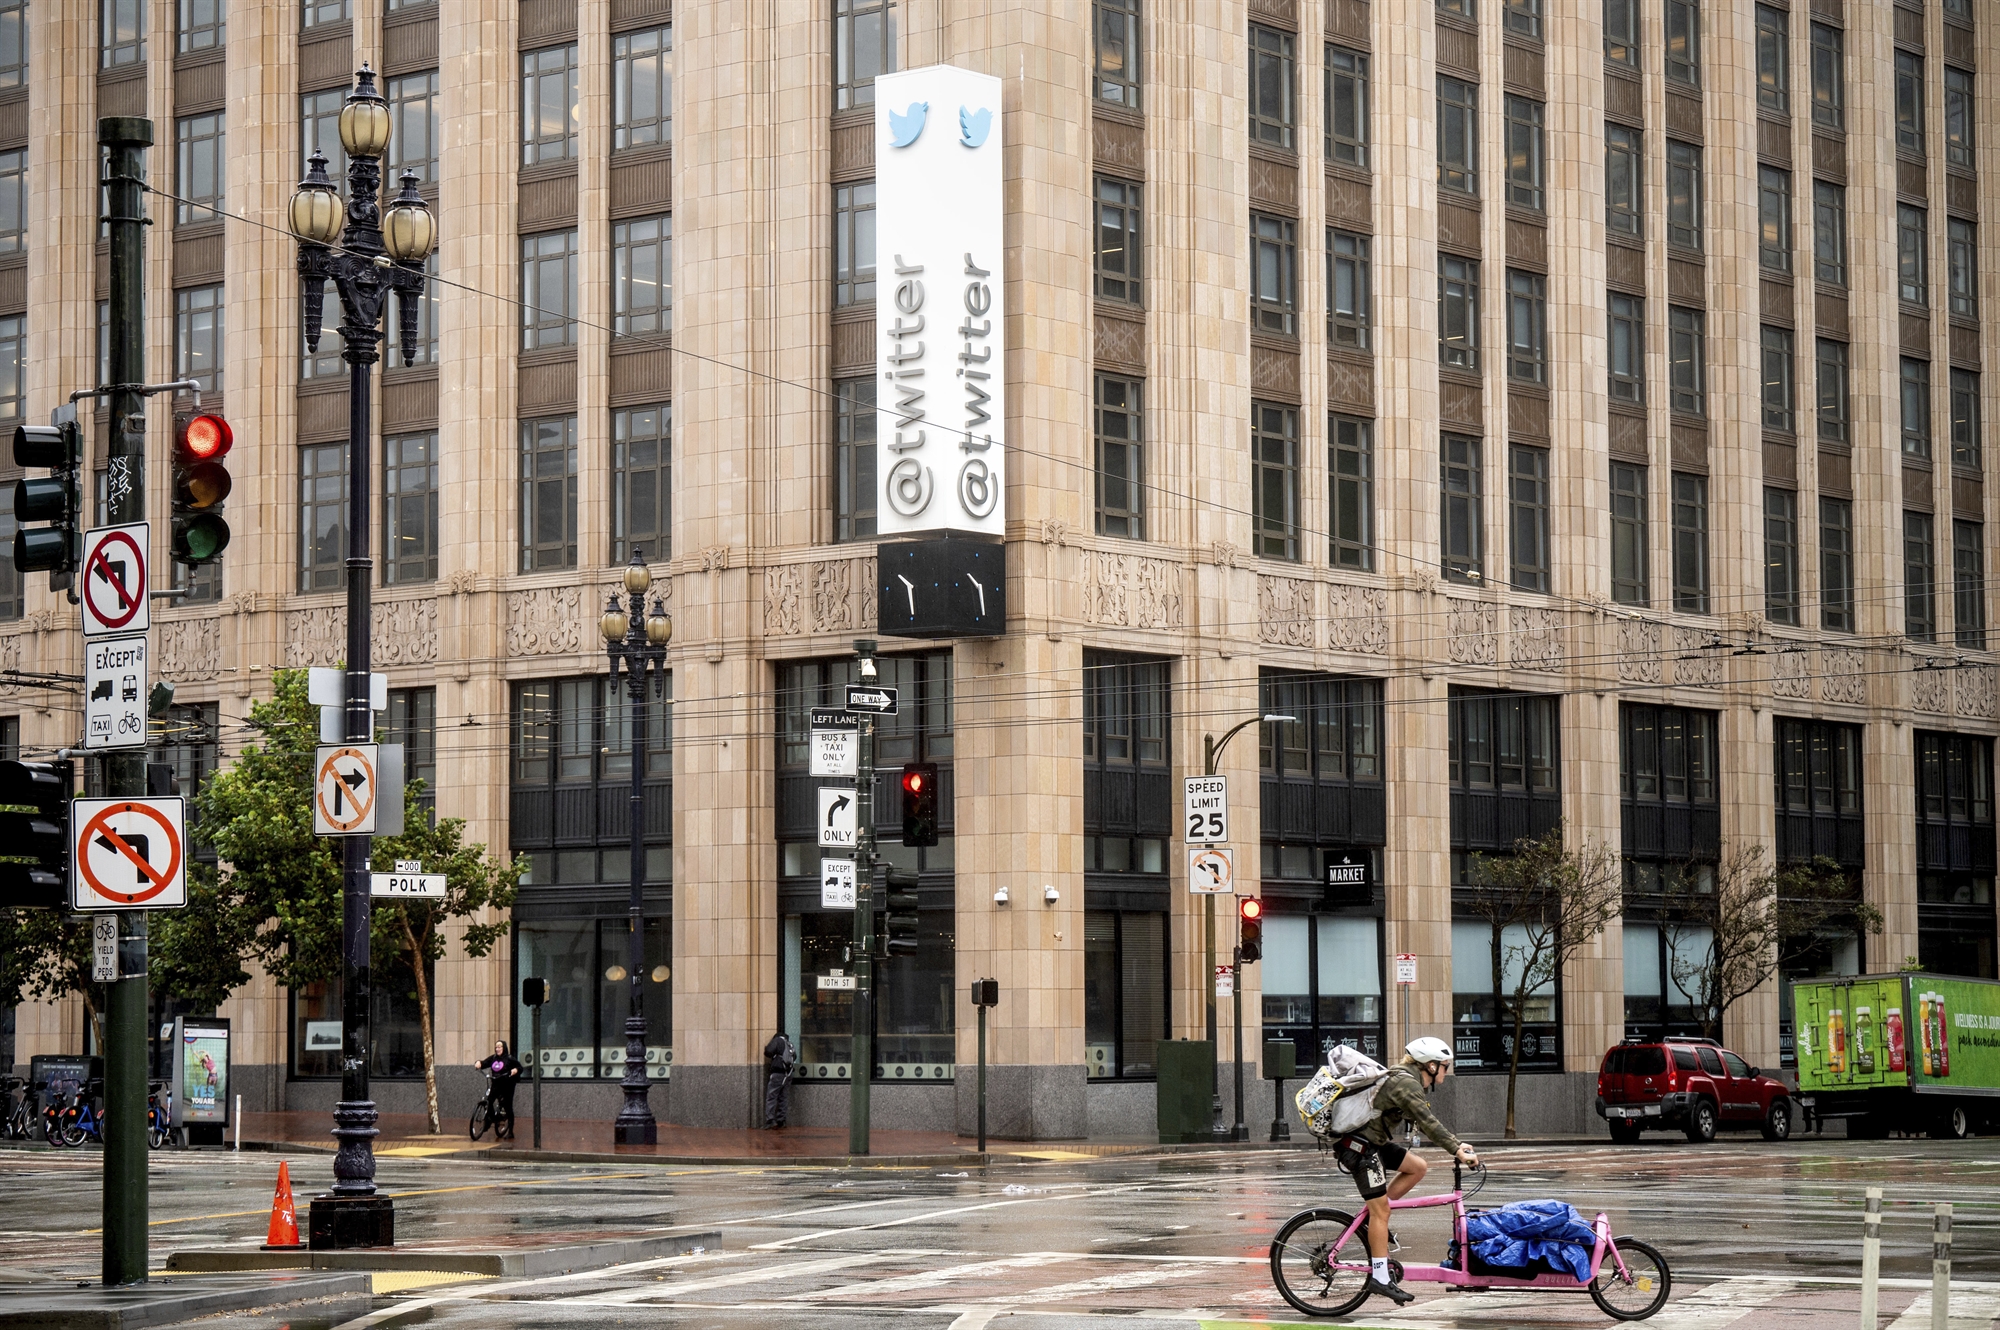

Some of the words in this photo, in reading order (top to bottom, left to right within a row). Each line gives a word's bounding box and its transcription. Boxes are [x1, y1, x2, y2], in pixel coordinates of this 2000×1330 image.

[885, 253, 934, 517] @twitter
[956, 252, 999, 519] @twitter
[96, 650, 135, 669] EXCEPT
[852, 694, 865, 703] ONE
[868, 696, 881, 704] WAY
[812, 715, 833, 724] LEFT
[835, 716, 857, 724] LANE
[93, 720, 110, 731] TAXI
[821, 733, 838, 741] BUS
[841, 733, 847, 741] &
[825, 743, 843, 751] TAXI
[822, 753, 845, 761] ONLY
[1188, 782, 1224, 793] SPEED
[1192, 798, 1220, 808] LIMIT
[1189, 813, 1224, 837] 25
[824, 830, 852, 842] ONLY
[404, 862, 419, 870] 000
[828, 864, 851, 873] EXCEPT
[1330, 868, 1364, 881] MARKET
[389, 878, 427, 892] POLK
[97, 945, 114, 954] YIELD
[102, 957, 110, 965] TO
[97, 967, 113, 976] PEDS
[1954, 1013, 1979, 1028] WELLNESS
[1979, 1014, 1983, 1029] IS
[1983, 1015, 1988, 1029] A
[1456, 1040, 1480, 1052] MARKET
[191, 1084, 215, 1098] YES
